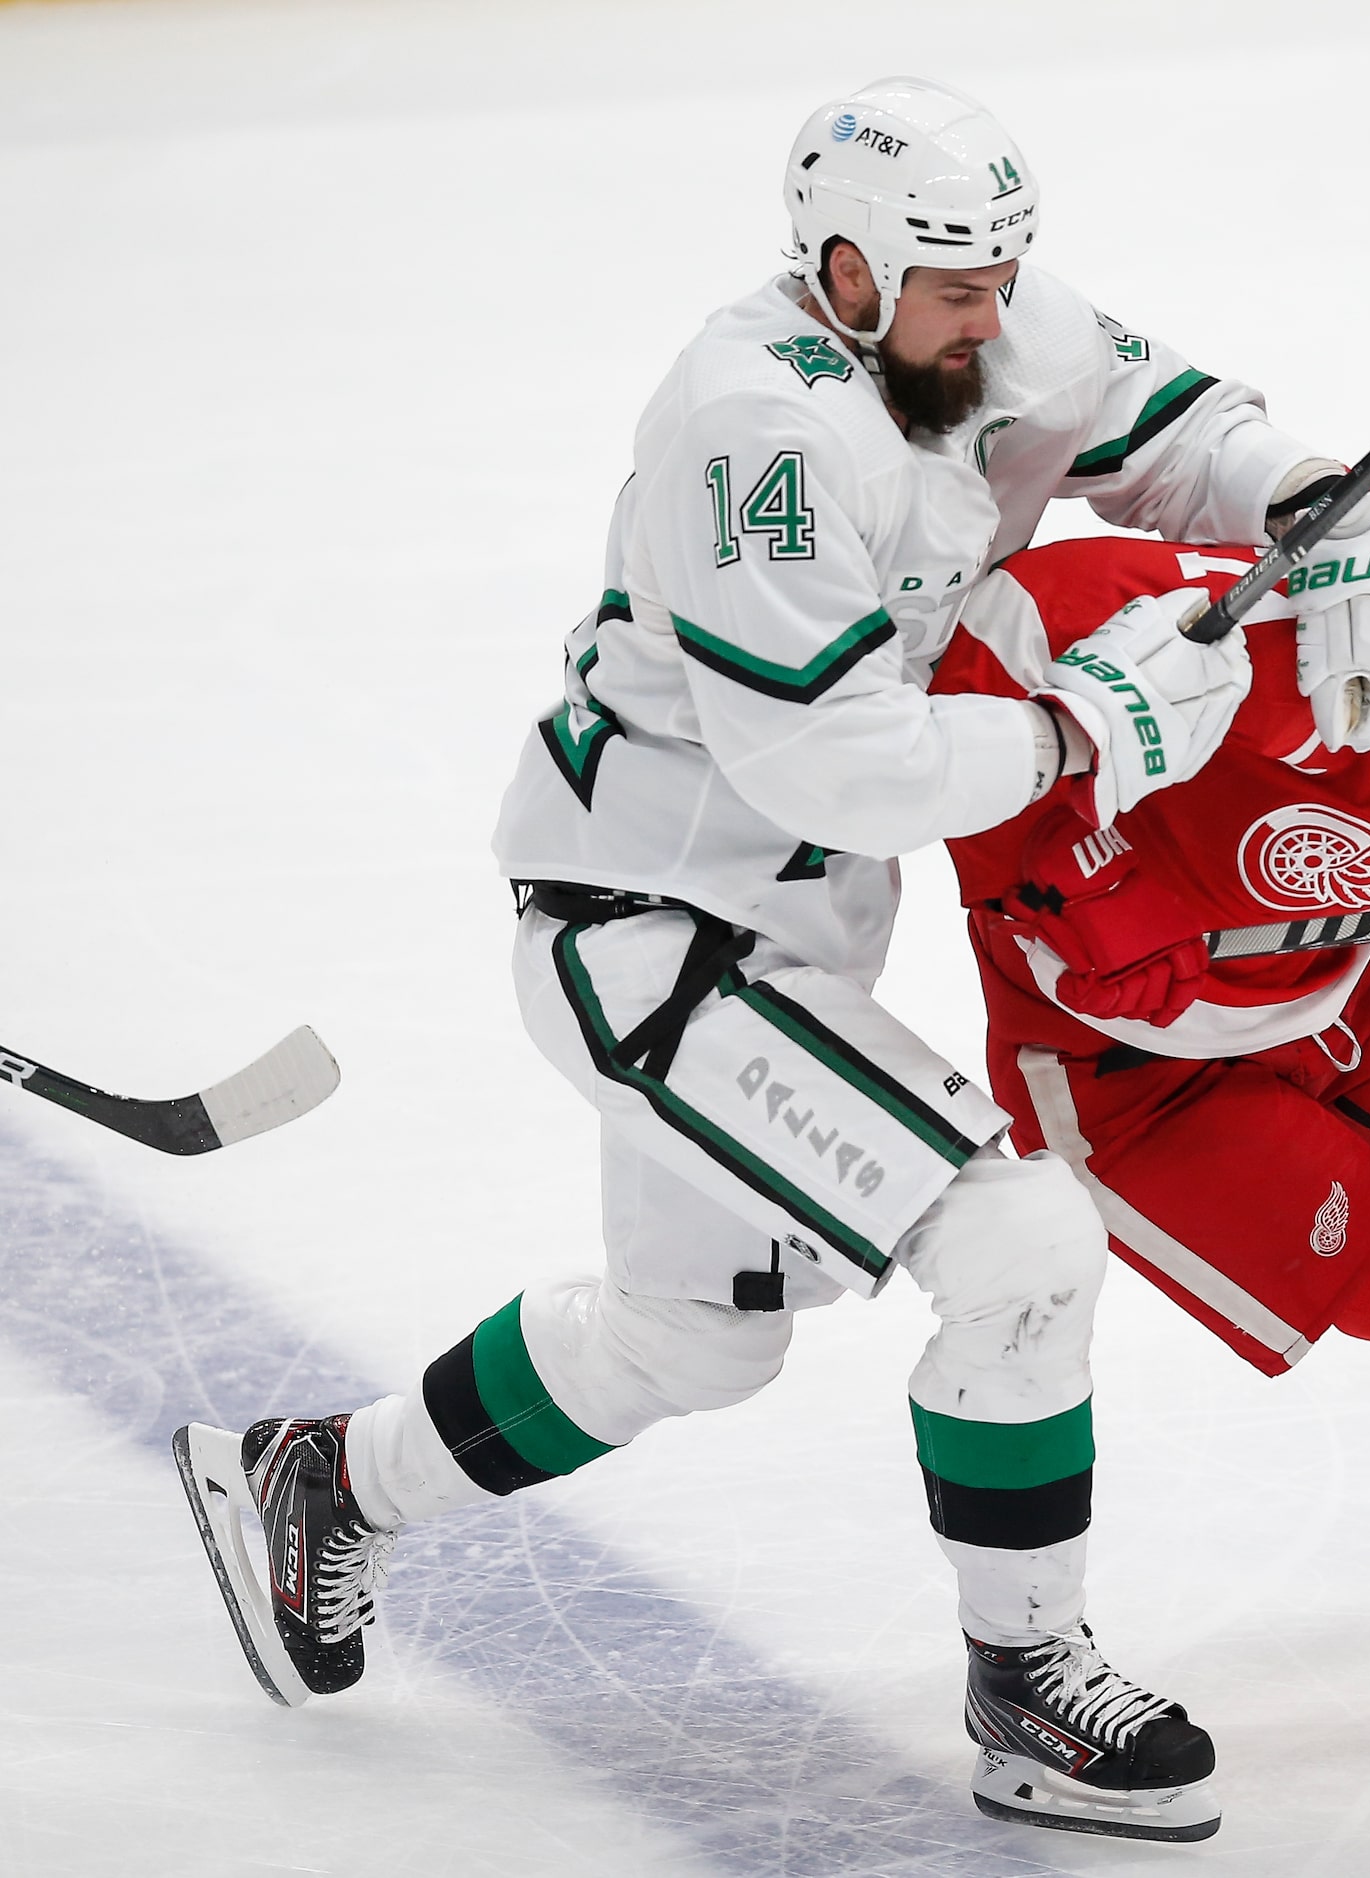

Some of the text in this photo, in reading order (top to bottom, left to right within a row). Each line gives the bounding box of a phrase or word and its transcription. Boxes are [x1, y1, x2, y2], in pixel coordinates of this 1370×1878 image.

[855, 127, 908, 158] AT&T
[988, 156, 1022, 192] 14
[990, 205, 1035, 232] CCM
[705, 451, 816, 568] 14
[736, 1056, 886, 1198] DALLAS
[284, 1523, 300, 1594] CCM
[1018, 1716, 1078, 1760] CCM
